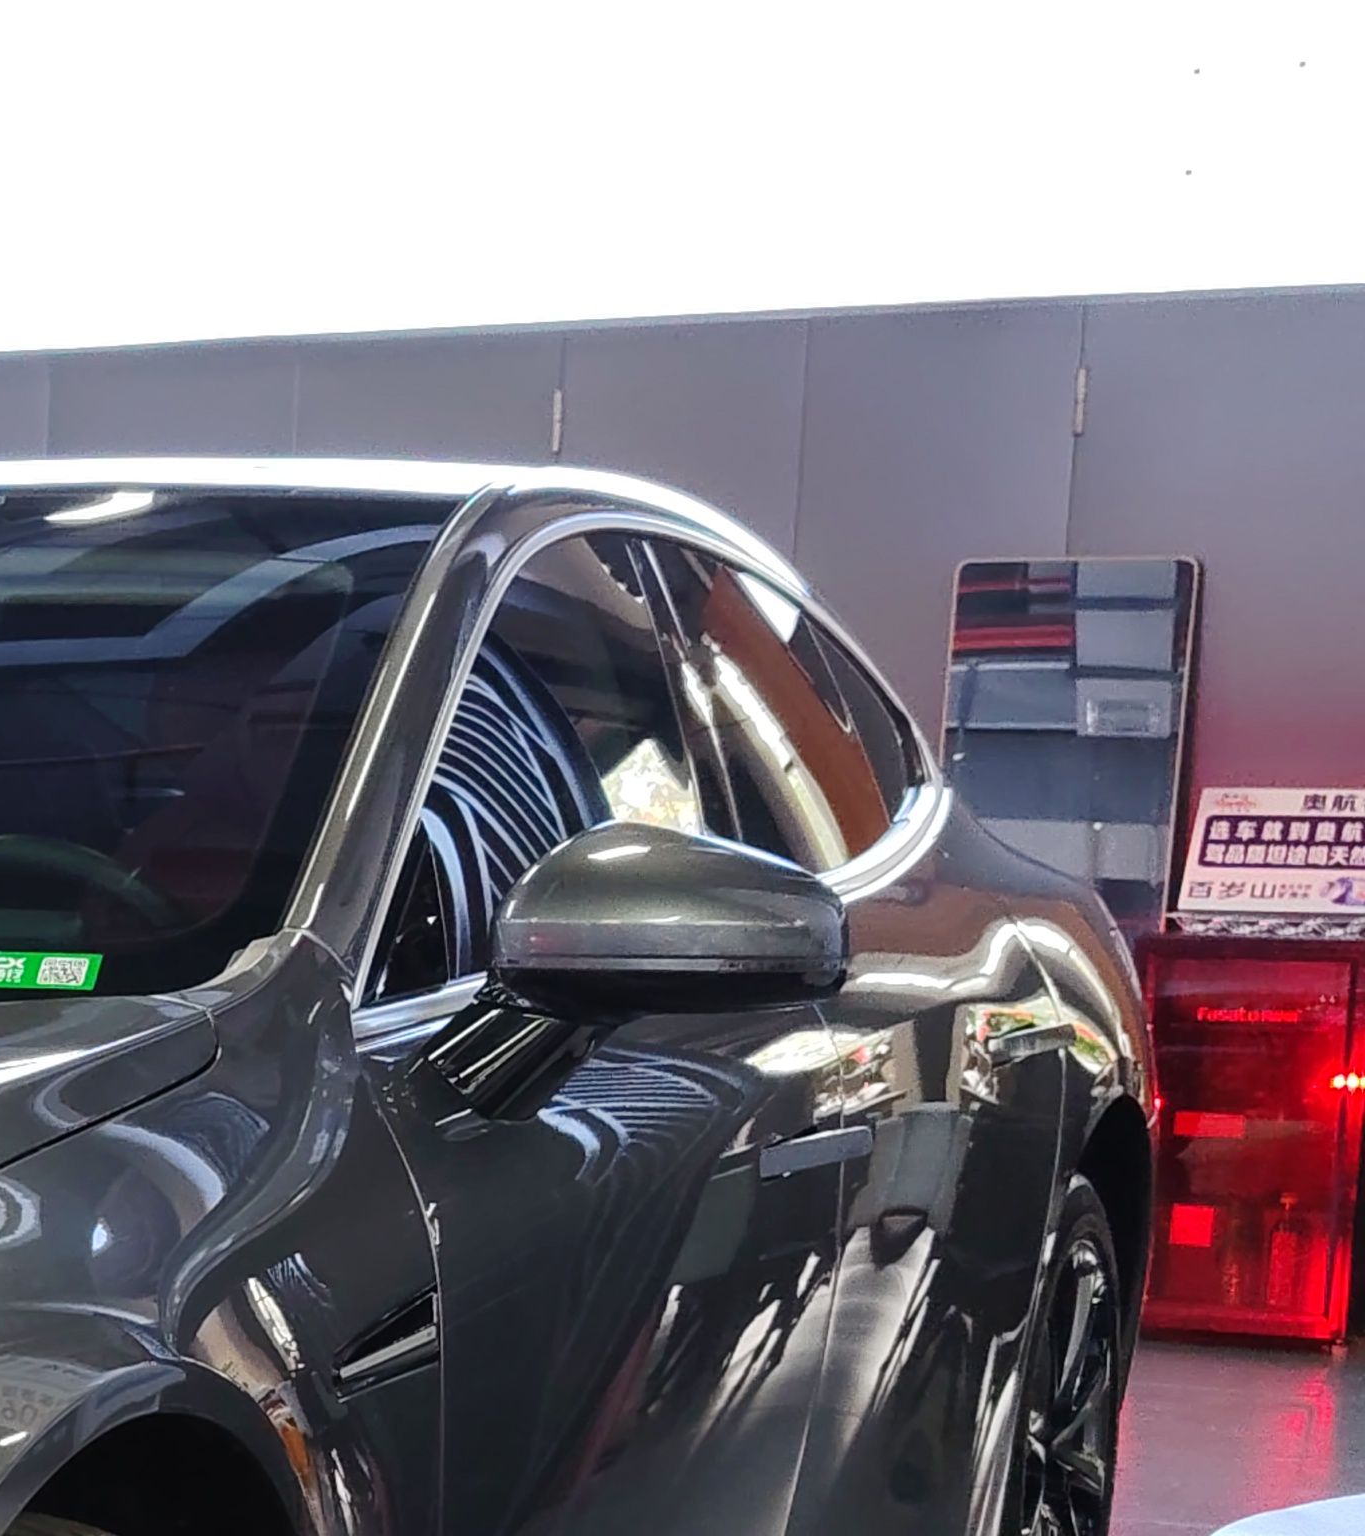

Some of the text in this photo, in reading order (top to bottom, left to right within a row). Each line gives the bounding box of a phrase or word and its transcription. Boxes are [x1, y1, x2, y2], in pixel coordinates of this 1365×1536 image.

[1302, 793, 1365, 813] 奥航
[1187, 881, 1277, 899] 百岁山
